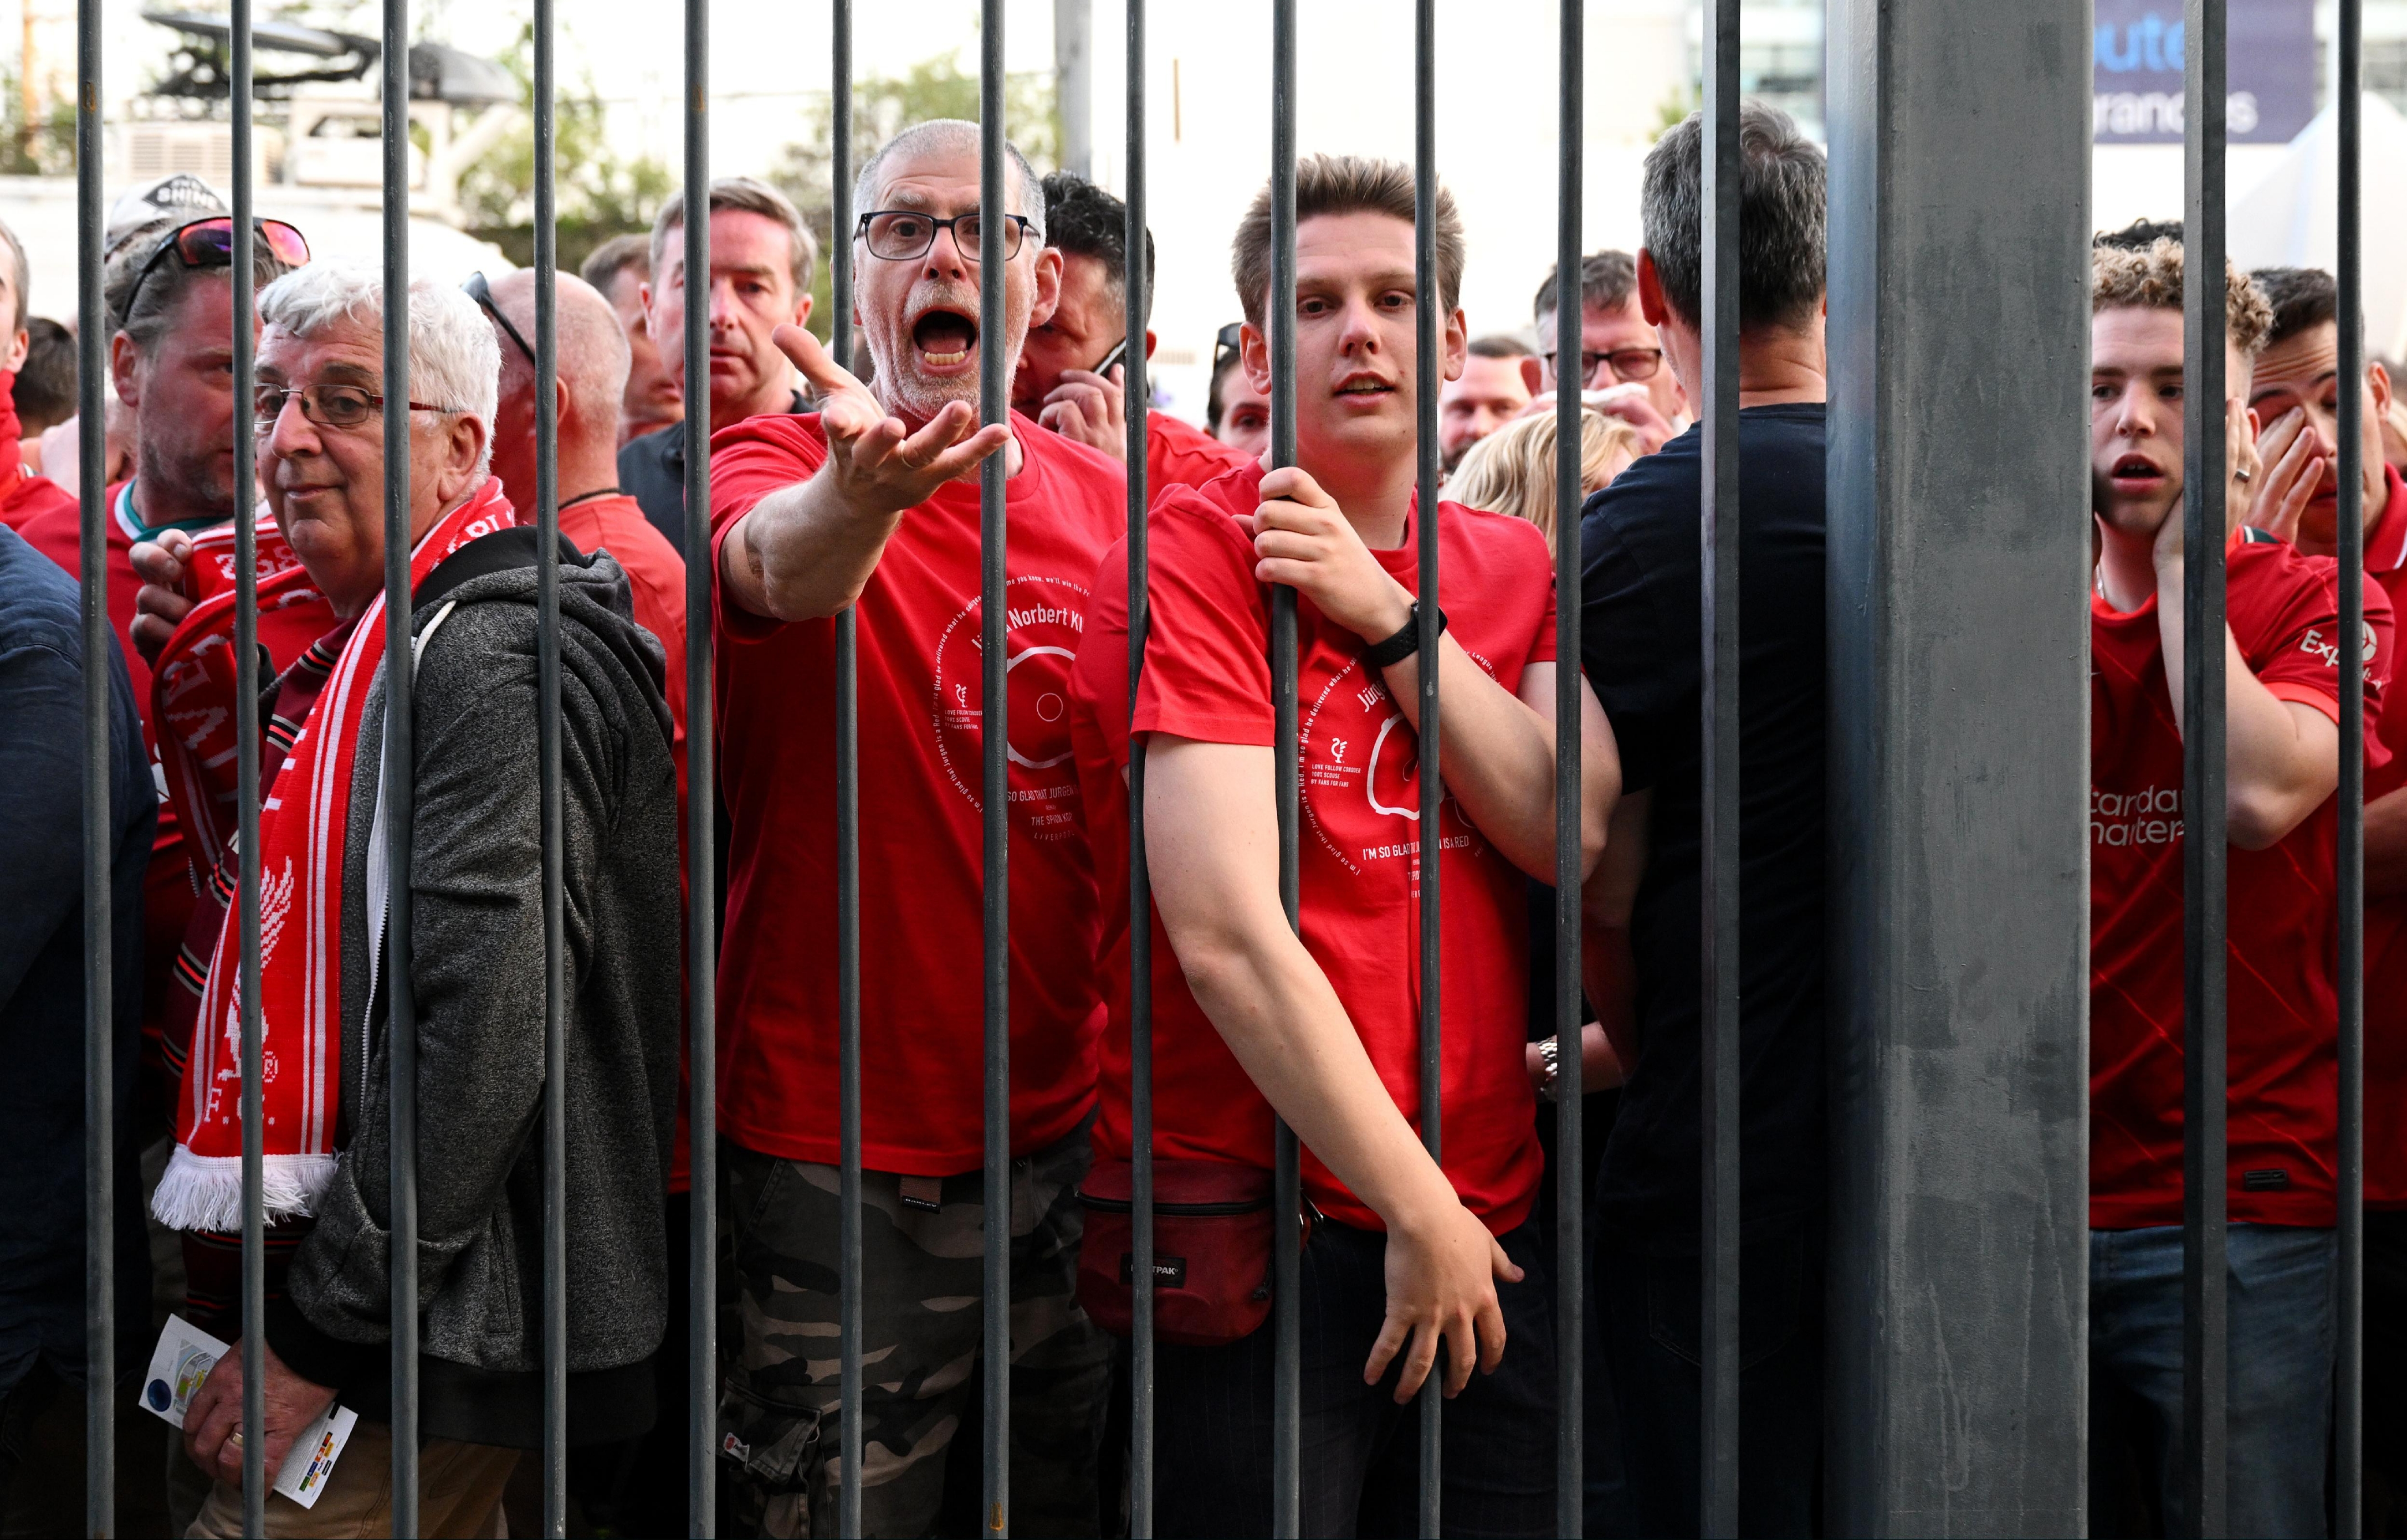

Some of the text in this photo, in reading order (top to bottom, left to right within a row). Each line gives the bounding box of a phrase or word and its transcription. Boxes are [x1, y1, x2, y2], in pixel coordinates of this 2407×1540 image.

[1017, 576, 1027, 584] you
[1073, 583, 1082, 593] the
[956, 611, 966, 619] he
[1008, 603, 1068, 629] Norbert
[946, 618, 959, 633] what
[935, 633, 948, 664] delivered
[1342, 665, 1351, 675] he
[933, 675, 941, 691] glad
[1329, 673, 1343, 687] what
[1310, 685, 1330, 717] delivered
[1305, 717, 1314, 727] he
[1300, 728, 1310, 744] glad
[946, 767, 957, 782] that
[954, 781, 969, 794] glad
[1020, 790, 1035, 802] GLAD
[1034, 788, 1047, 800] THAT
[1049, 785, 1074, 799] JURGEN
[1031, 812, 1072, 826] THE SPION KOP
[1316, 830, 1328, 844] that
[1326, 844, 1341, 858] glad
[1363, 848, 1377, 860] I'M
[1379, 845, 1391, 859] SO
[1392, 843, 1411, 857] GLAD
[1443, 837, 1450, 849] IS
[1450, 839, 1455, 848] A
[1455, 835, 1469, 848] RED
[1341, 857, 1349, 865] so
[1349, 864, 1360, 875] I'm
